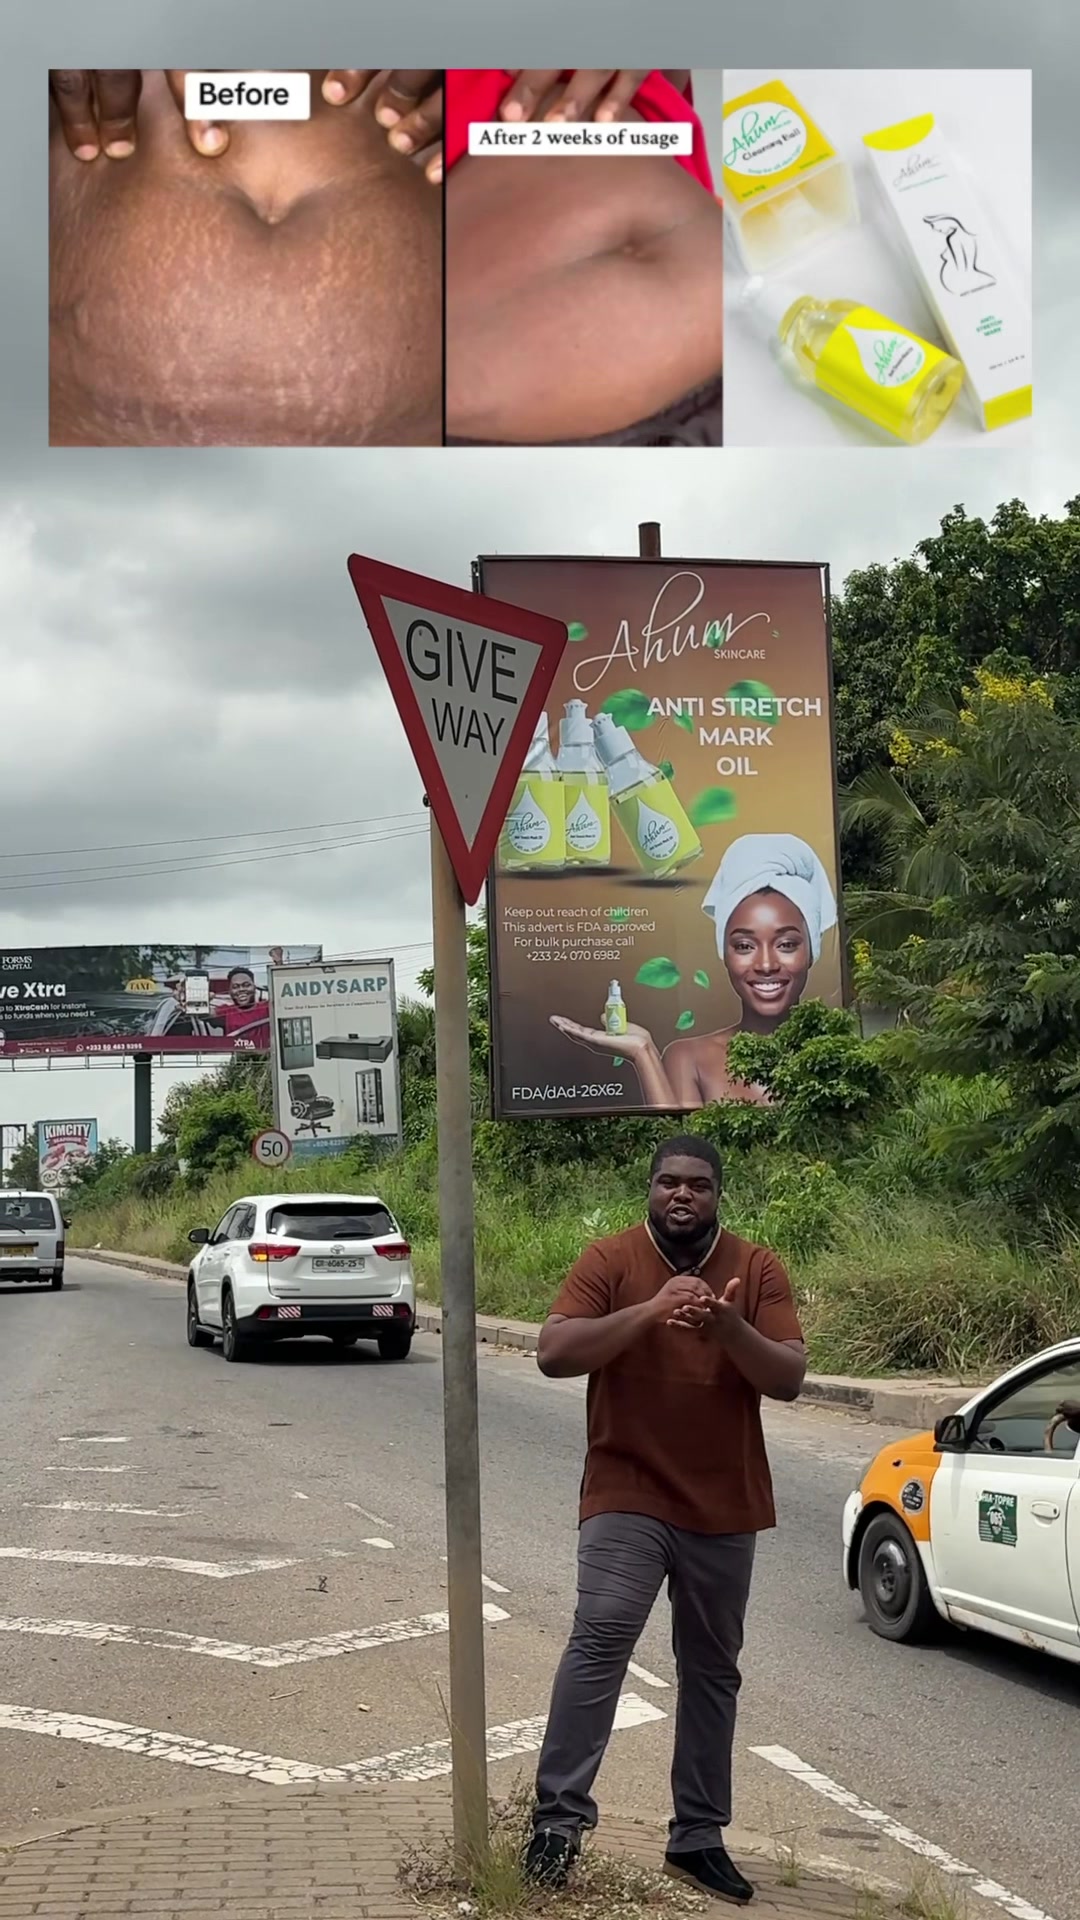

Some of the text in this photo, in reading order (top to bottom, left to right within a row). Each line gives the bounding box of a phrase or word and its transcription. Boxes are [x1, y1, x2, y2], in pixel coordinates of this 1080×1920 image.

[723, 109, 789, 167] Ahum
[573, 571, 771, 692] Ahum
[406, 619, 518, 705] GIVE
[713, 649, 766, 660] SKINCARE
[647, 696, 822, 717] ANTI STRETCH
[431, 697, 505, 757] WAY
[699, 727, 774, 747] MARK
[716, 756, 759, 776] OIL
[508, 811, 547, 837] Ahum
[642, 820, 670, 850] Ahum
[504, 906, 649, 919] Keep out reach of children
[502, 921, 656, 934] This advert is FDA approved
[514, 935, 635, 949] For bulk purchase call
[2, 956, 33, 964] FORMS
[526, 950, 620, 961] +233 24 070 6982
[23, 982, 67, 998] Xtra
[281, 976, 388, 998] ANDYSARP
[13, 1012, 34, 1020] funds
[34, 1011, 55, 1019] when
[55, 1011, 70, 1020] you
[70, 1010, 89, 1018] need
[14, 1003, 49, 1011] XtraCash
[61, 1002, 87, 1010] instant
[234, 1038, 256, 1047] XTRA
[512, 1083, 624, 1101] FDA/dAd-26X62
[45, 1123, 90, 1140] KIMCITY
[261, 1141, 283, 1157] 50
